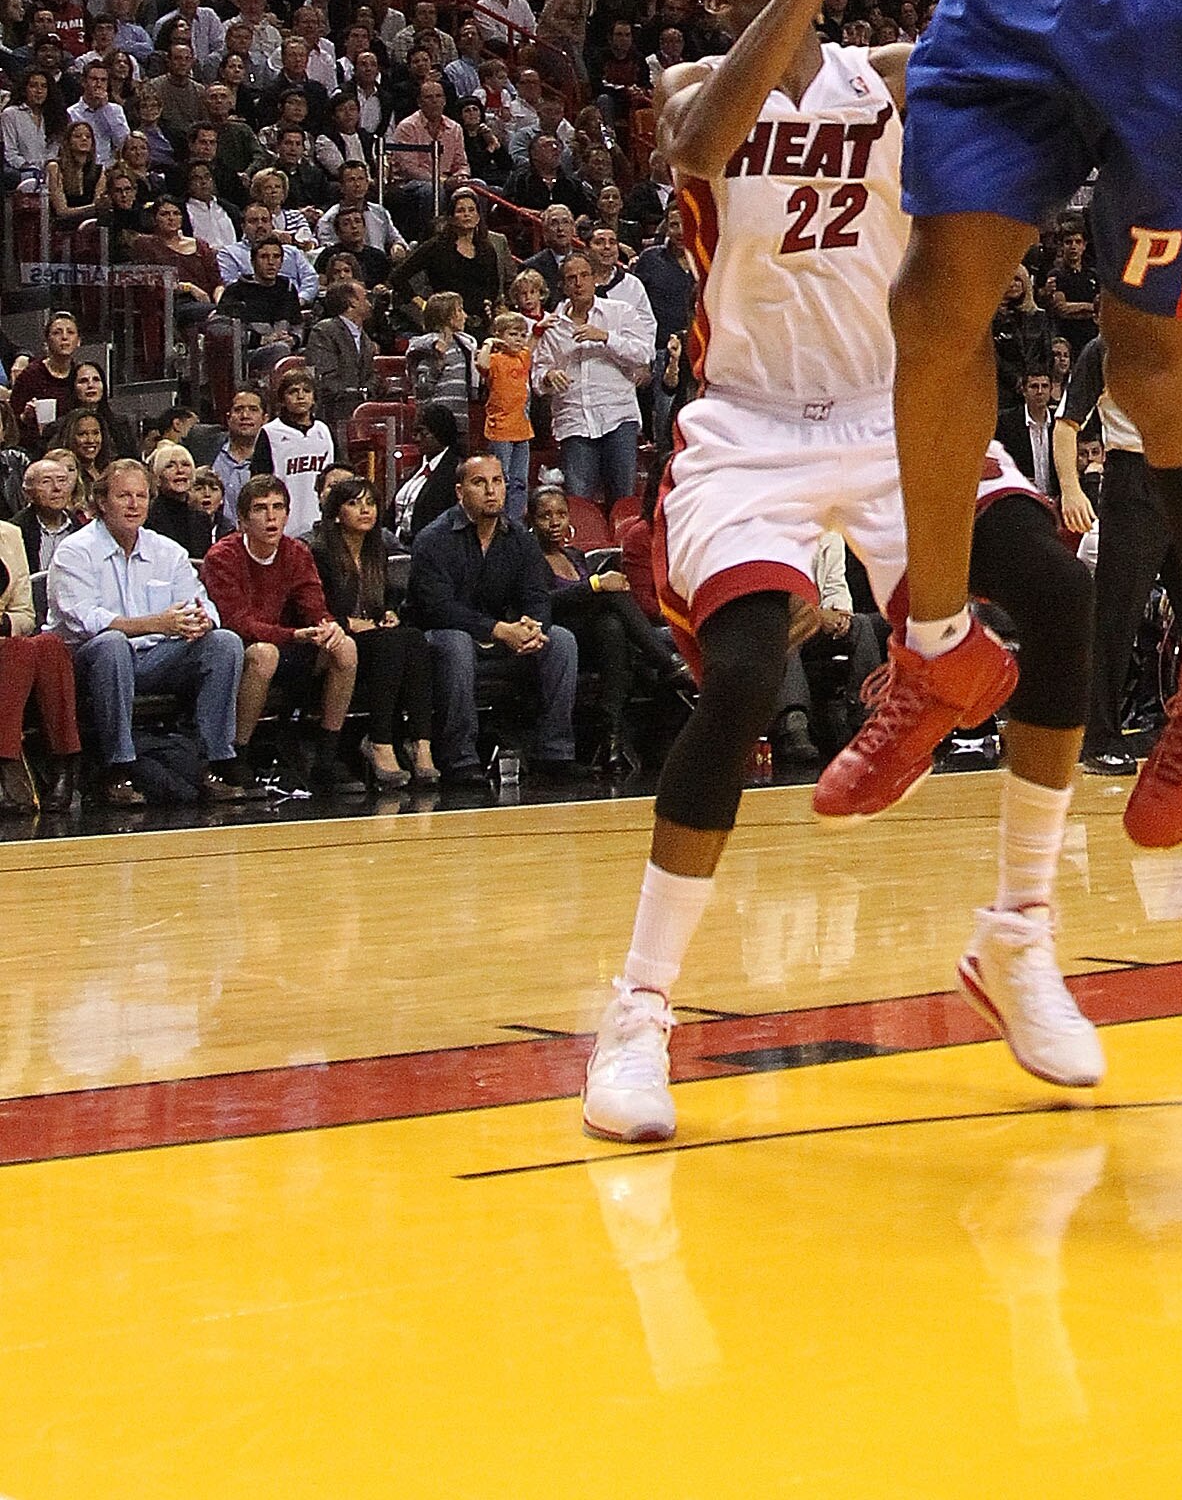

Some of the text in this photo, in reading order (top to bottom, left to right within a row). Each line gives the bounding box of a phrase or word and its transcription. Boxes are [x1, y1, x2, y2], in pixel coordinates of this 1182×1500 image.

[725, 102, 894, 179] HEAT
[780, 183, 869, 255] 22
[286, 451, 328, 475] HEAT
